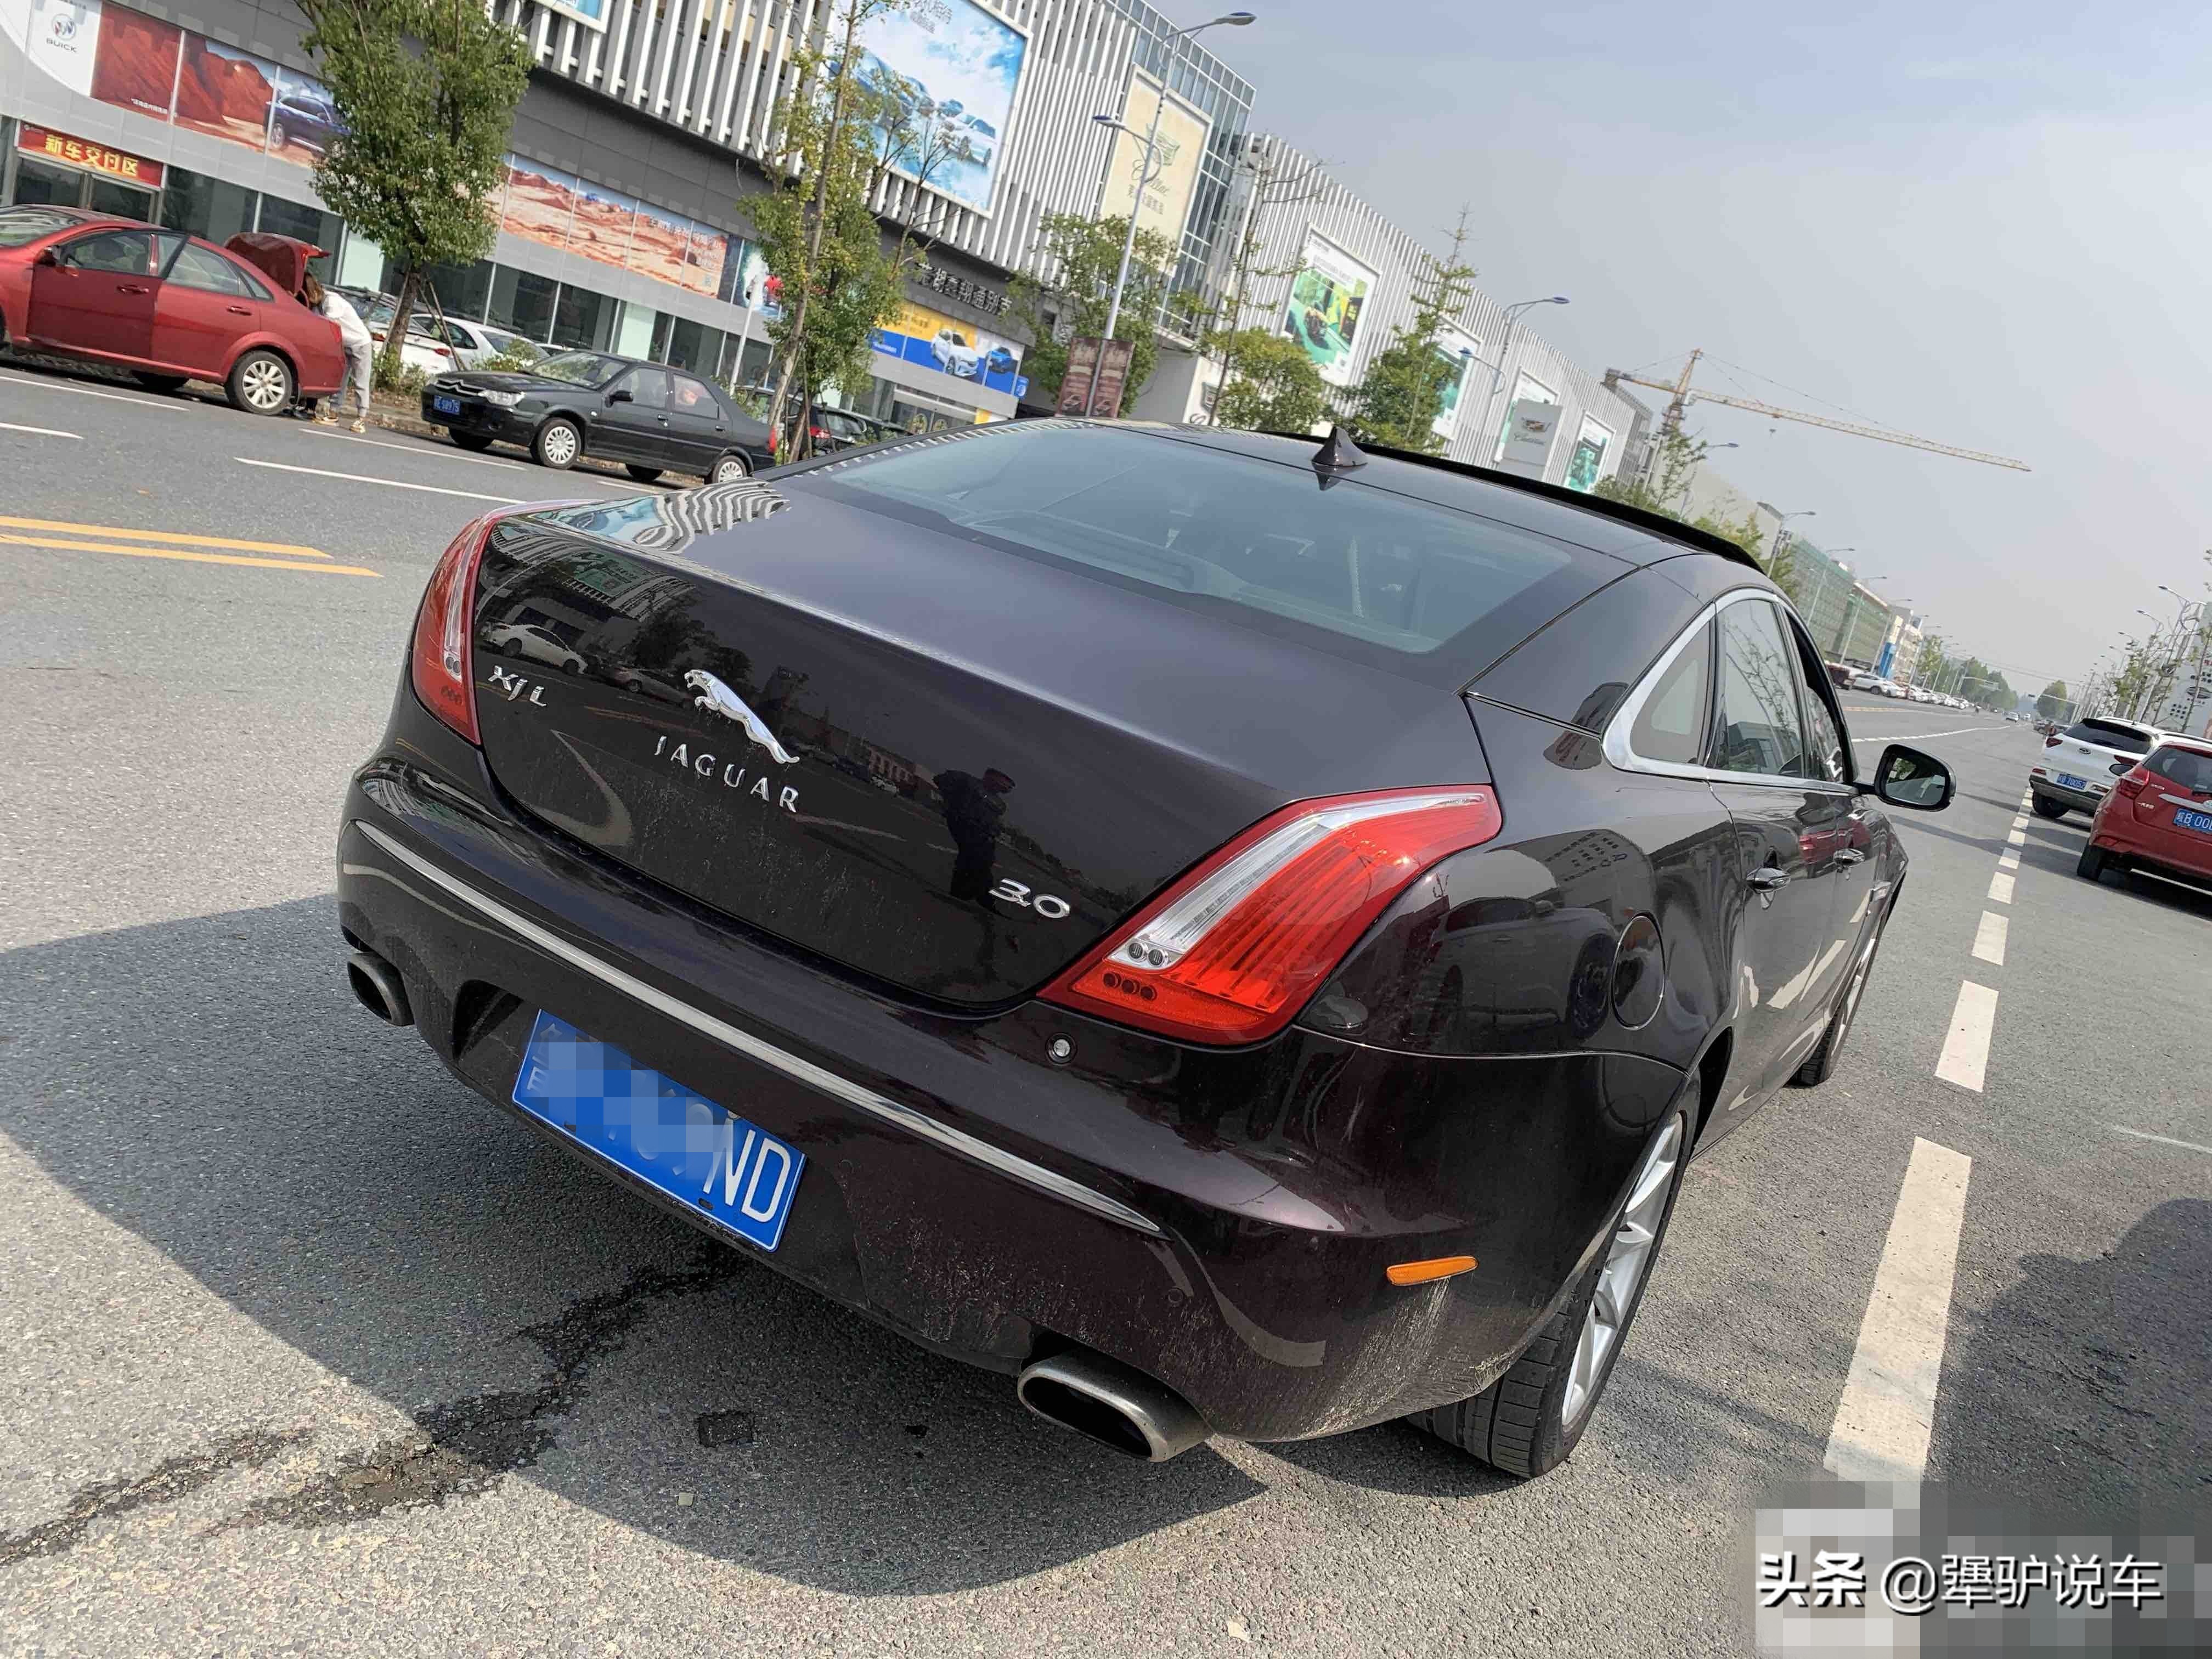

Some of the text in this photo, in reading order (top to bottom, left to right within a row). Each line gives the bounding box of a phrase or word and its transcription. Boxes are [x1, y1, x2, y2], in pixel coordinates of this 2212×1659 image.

[46, 38, 77, 53] BUICK
[45, 134, 138, 176] 新车交付区
[488, 665, 548, 707] XJL
[654, 735, 800, 813] JAGUAR
